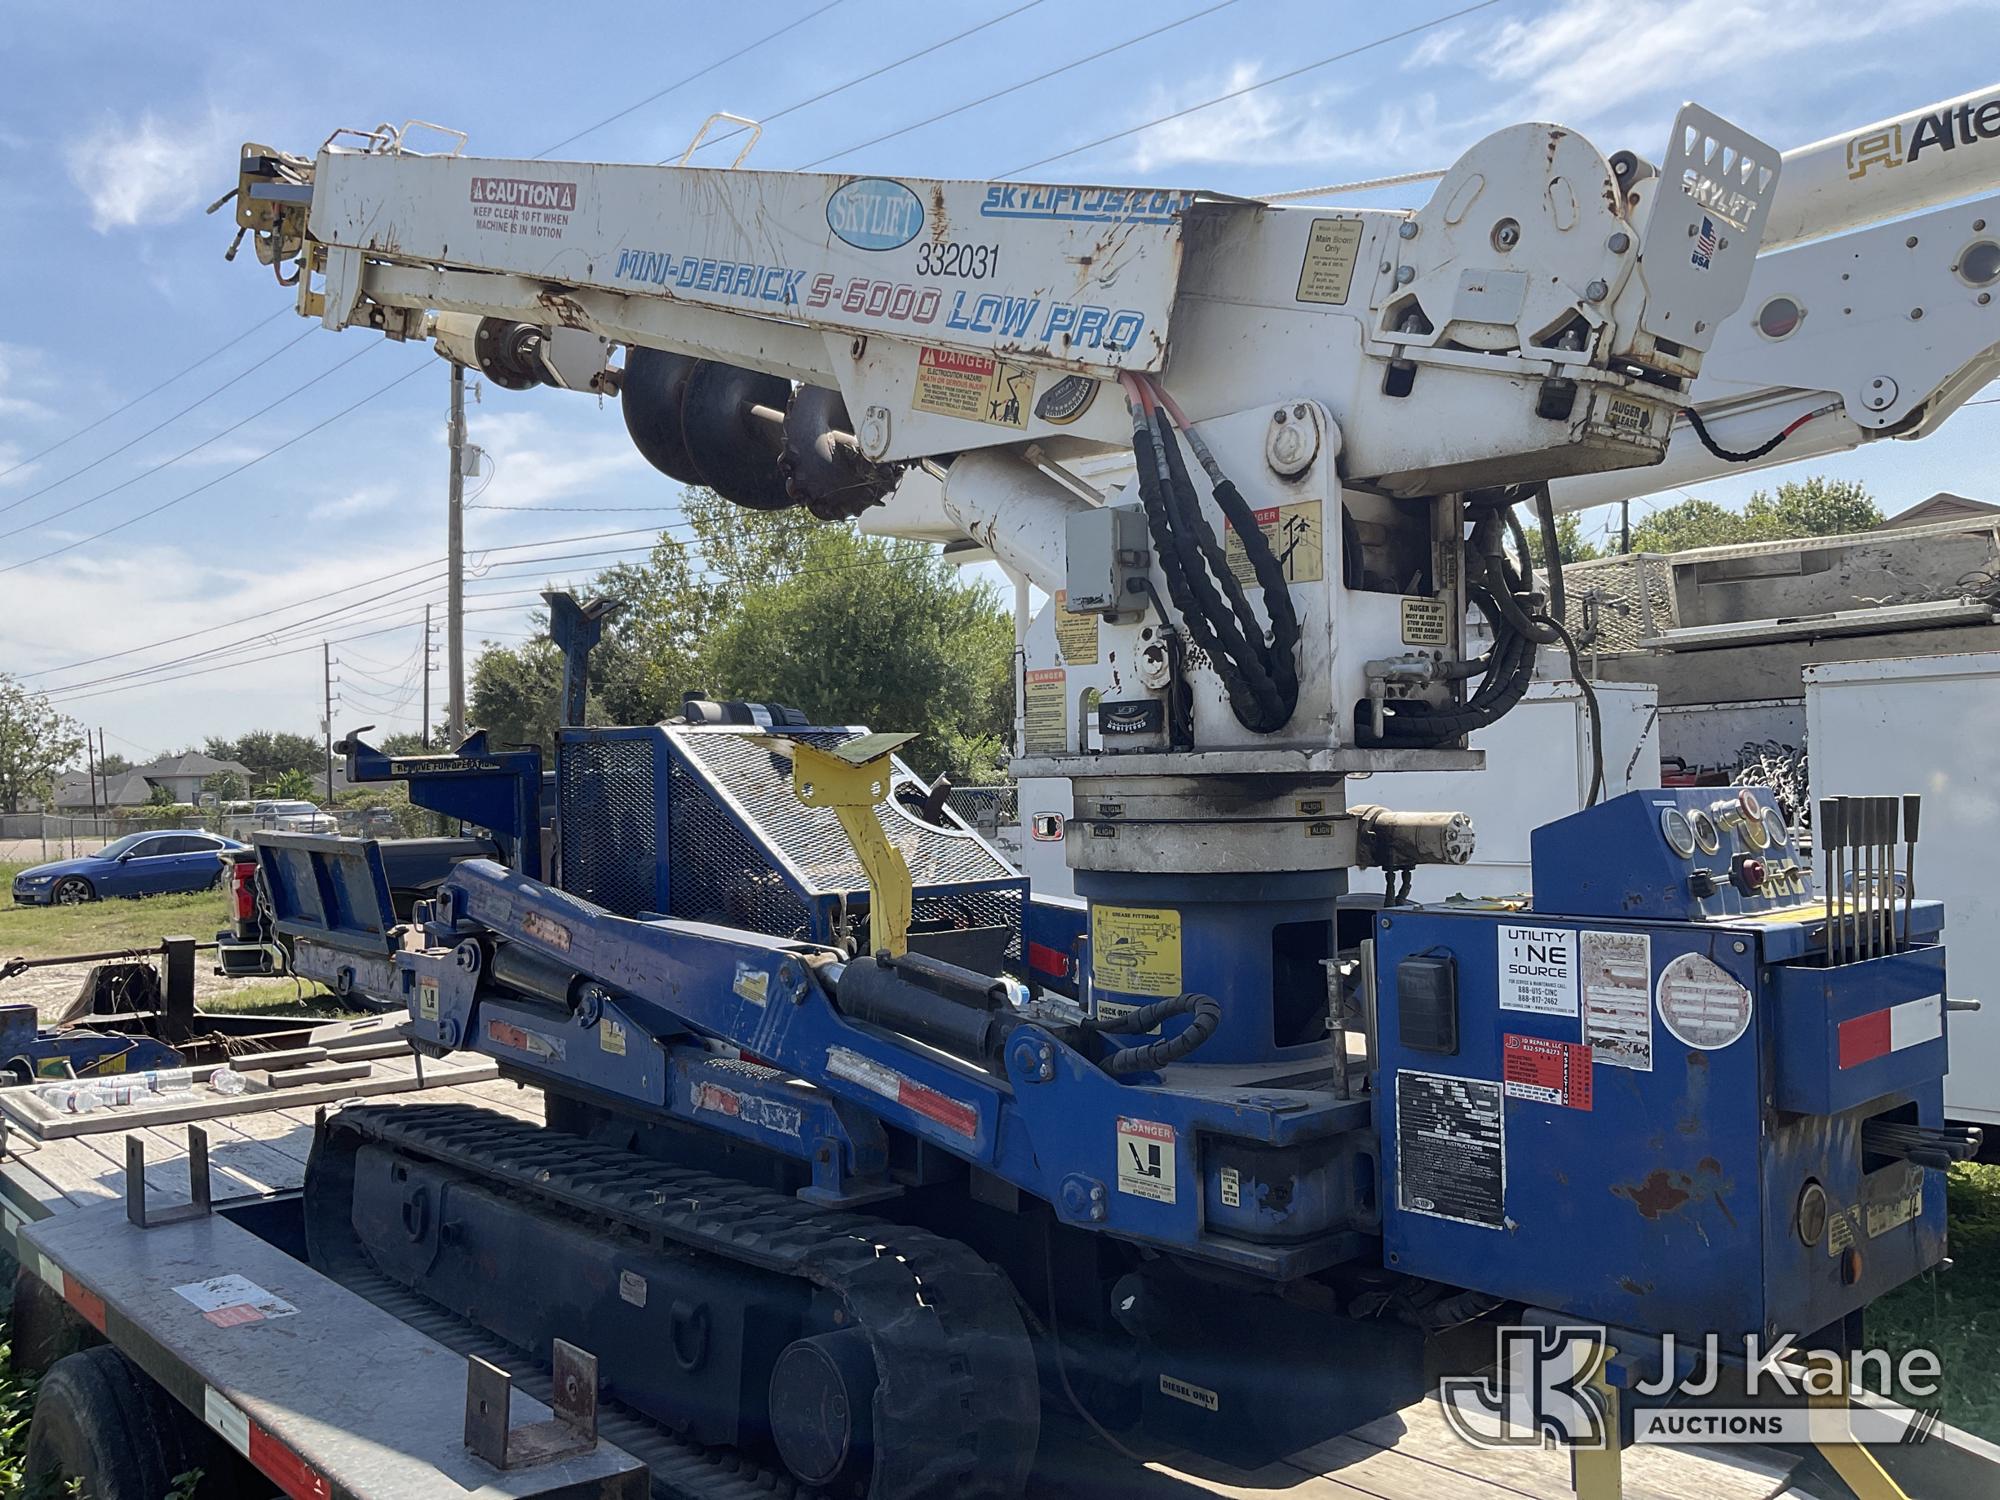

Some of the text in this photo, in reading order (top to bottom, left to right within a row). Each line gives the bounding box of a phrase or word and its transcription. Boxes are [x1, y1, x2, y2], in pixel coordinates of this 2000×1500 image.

[486, 181, 559, 207] CAUTION
[1681, 168, 1757, 223] SKYLIFT
[473, 206, 569, 225] KEEP CLEAR 10 FT WHEN
[833, 190, 917, 238] SKYLIFT
[476, 219, 562, 239] MACHINE IS IN MOTION
[1315, 235, 1332, 243] Main
[1325, 244, 1340, 254] Only
[916, 242, 1000, 279] 332031
[1691, 253, 1711, 270] USA
[615, 248, 1145, 353] MINI-DERRICK S-6000 LOW PRO
[940, 350, 993, 370] DANGER
[1612, 401, 1641, 419] AUGER
[1607, 412, 1639, 429] LEASE
[1034, 670, 1064, 681] DANGER
[1096, 828, 1114, 836] ALIGN
[1508, 929, 1566, 942] UTILITY
[1509, 964, 1567, 978] SOURCE
[1518, 994, 1558, 1006] 888-817-2462
[1099, 1006, 1117, 1016] CHECK
[1132, 1124, 1171, 1138] DANGER
[1417, 1136, 1483, 1152] OPERATING INSTRUCTIONS
[1162, 1380, 1215, 1405] DIESEL ONLY
